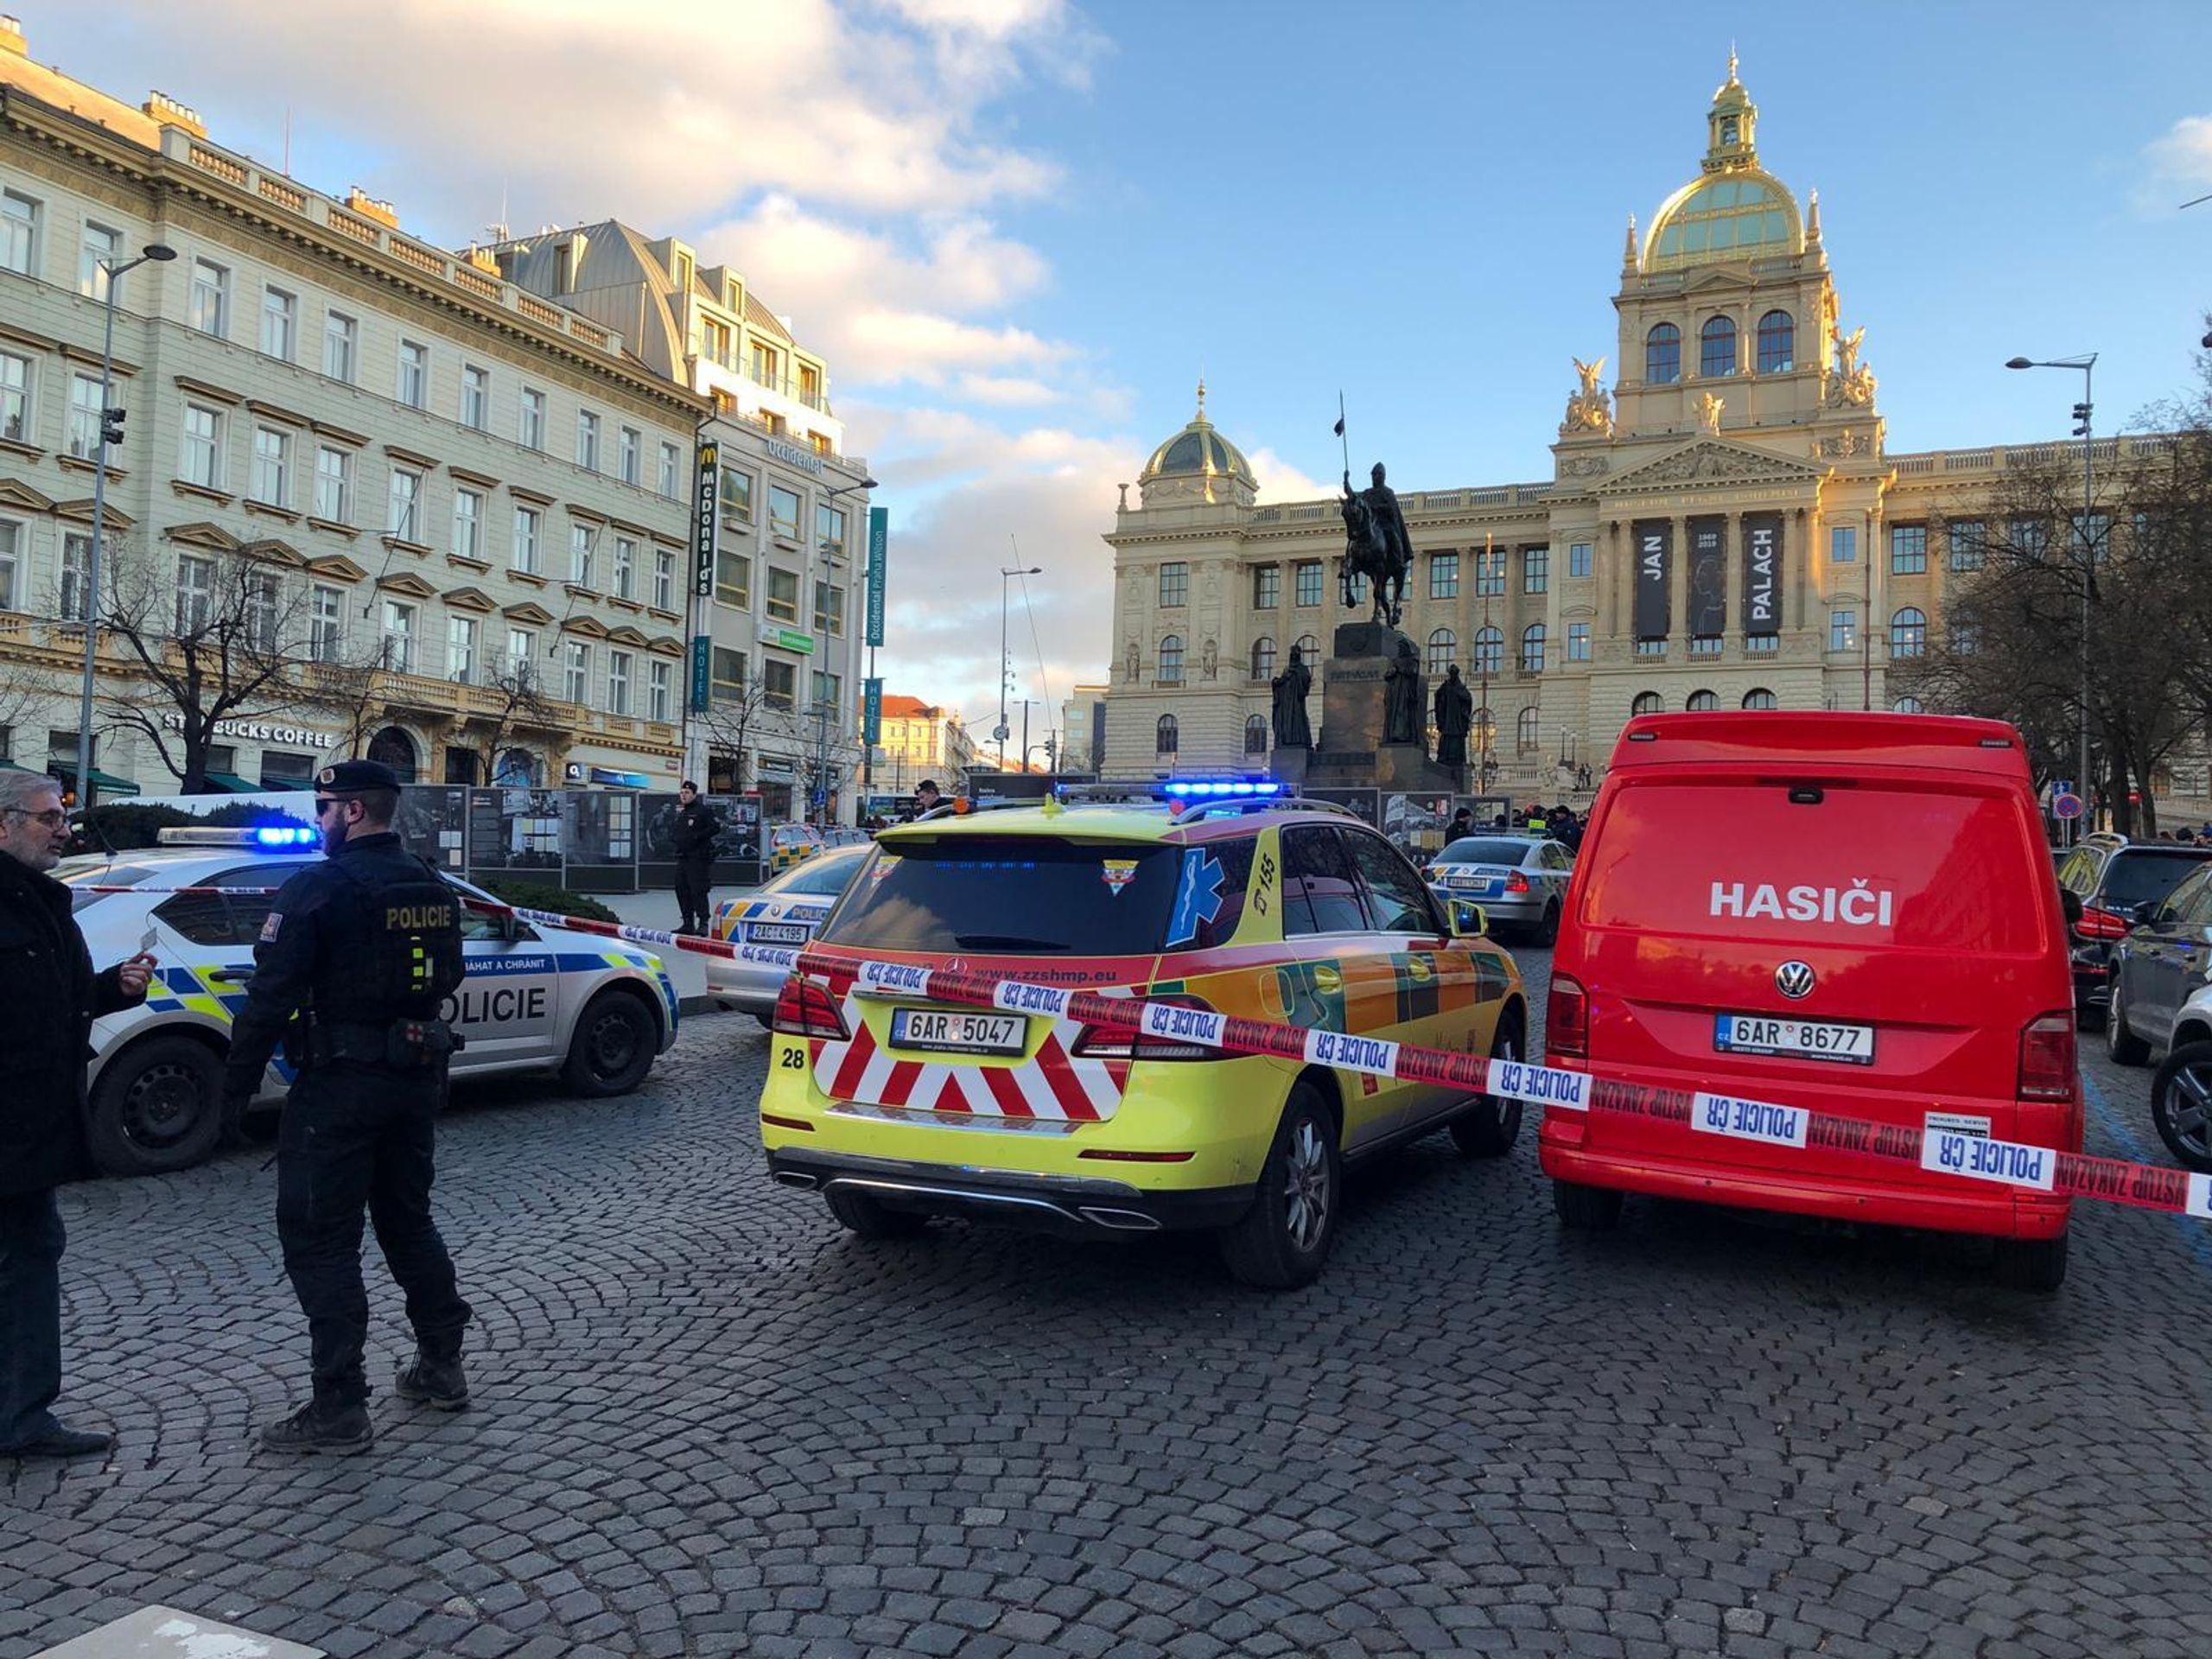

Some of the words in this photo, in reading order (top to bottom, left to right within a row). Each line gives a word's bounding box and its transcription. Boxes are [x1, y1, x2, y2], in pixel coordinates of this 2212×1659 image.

[1643, 536, 1662, 581] JAN
[1752, 529, 1772, 620] PALACH
[697, 644, 707, 706] HOTEL
[163, 713, 270, 740] STBUCKS
[273, 727, 333, 748] COFFEE
[1259, 852, 1275, 892] 155
[386, 905, 451, 931] POLICIE
[1710, 878, 1892, 926] HASIČI
[496, 962, 504, 970] A
[505, 957, 546, 970] CHRÁNIT
[884, 965, 925, 989] POLICIE
[975, 968, 1117, 984] www.zzshmp.eu
[437, 987, 547, 1025] OLICIE
[1021, 985, 1065, 1013] POLICIE
[910, 1014, 948, 1040] 6AR
[963, 1018, 1014, 1044] 5047
[1151, 1007, 1170, 1035] ČR
[1172, 1009, 1218, 1039] POLICIE
[1736, 1020, 1780, 1045] 6AR
[1800, 1026, 1860, 1052] 8677
[781, 1048, 804, 1069] 28
[1316, 1033, 1335, 1065] ČR
[1338, 1035, 1389, 1070] POLICIE
[1501, 1064, 1522, 1097] ČR
[1525, 1067, 1582, 1103] POLICIE
[1707, 1097, 1729, 1134] ČR
[1734, 1102, 1797, 1140] POLICIE
[1940, 1135, 1965, 1173] ČR
[1970, 1141, 2043, 1181] POLICIE
[2133, 1168, 2186, 1207] VSTUP
